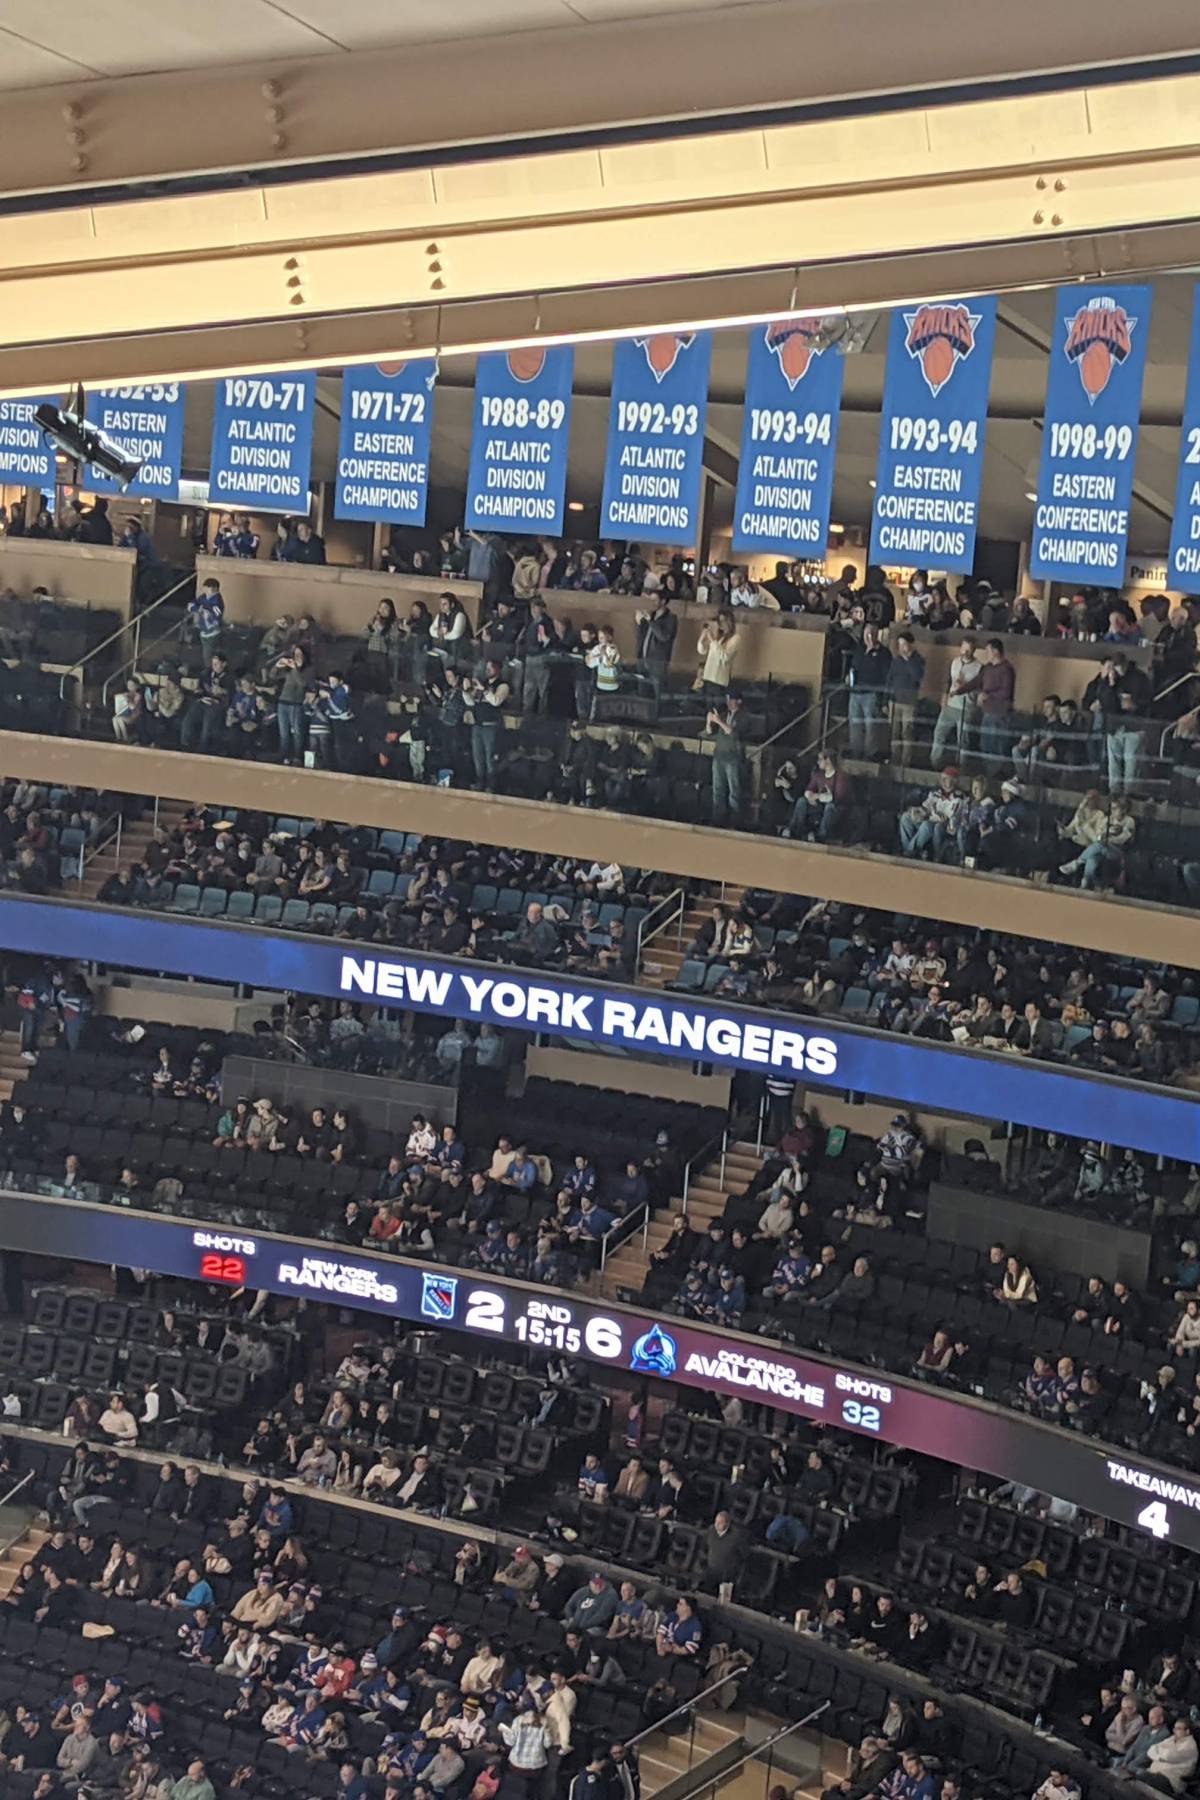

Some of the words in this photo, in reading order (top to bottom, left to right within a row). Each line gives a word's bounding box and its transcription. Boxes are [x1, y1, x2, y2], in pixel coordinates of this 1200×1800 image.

[225, 379, 305, 411] 1970-71
[352, 391, 426, 423] 1971-72
[1, 403, 38, 422] STER
[103, 410, 166, 433] EASTERN
[482, 396, 565, 430] 1988-89
[618, 401, 698, 435] 1992-93
[228, 419, 296, 443] ATLANTIC
[751, 409, 831, 446] 1993-94
[890, 417, 978, 454] 1993-94
[1050, 423, 1132, 460] 1998-99
[230, 446, 291, 469] DIVISION
[354, 433, 414, 455] EASTERN
[485, 440, 551, 463] ATLANTIC
[620, 446, 686, 470] ATLANTIC
[92, 464, 172, 486] CIONS
[339, 458, 426, 484] CONFERENCE
[487, 468, 545, 491] DIVISION
[753, 455, 818, 481] ATLANTIC
[894, 465, 961, 492] EASTERN
[217, 470, 300, 496] CHAMPIONS
[343, 484, 418, 510] CHAMPIONS
[621, 474, 680, 499] DIVISION
[1053, 473, 1116, 500] EASTERN
[474, 494, 555, 520] CHAMPIONS
[754, 485, 811, 511] DIVISION
[877, 495, 975, 524] CONFERENCE
[609, 501, 688, 528] CHAMPIONS
[741, 513, 820, 541] CHAMPIONS
[1036, 505, 1128, 535] CONFERENCE
[879, 526, 965, 555] CHAMPIONS
[1039, 537, 1118, 567] CHAMPIONS
[339, 956, 453, 1007] NEW
[459, 975, 596, 1033] YORK
[601, 998, 839, 1076] RANGERS
[193, 1232, 255, 1255] SHOTS
[202, 1254, 244, 1282] 22
[302, 1258, 337, 1275] NEW
[338, 1263, 378, 1282] YORK
[278, 1263, 398, 1303] RANGERS
[465, 1290, 505, 1332] 2
[527, 1301, 572, 1324] 2ND
[515, 1317, 581, 1352] 15:15
[585, 1317, 622, 1358] 6
[717, 1350, 796, 1381] COLORADO
[684, 1353, 825, 1408] AVALANCHE
[835, 1374, 892, 1403] SHOTS
[842, 1400, 880, 1431] 32
[1137, 1500, 1170, 1538] 4
